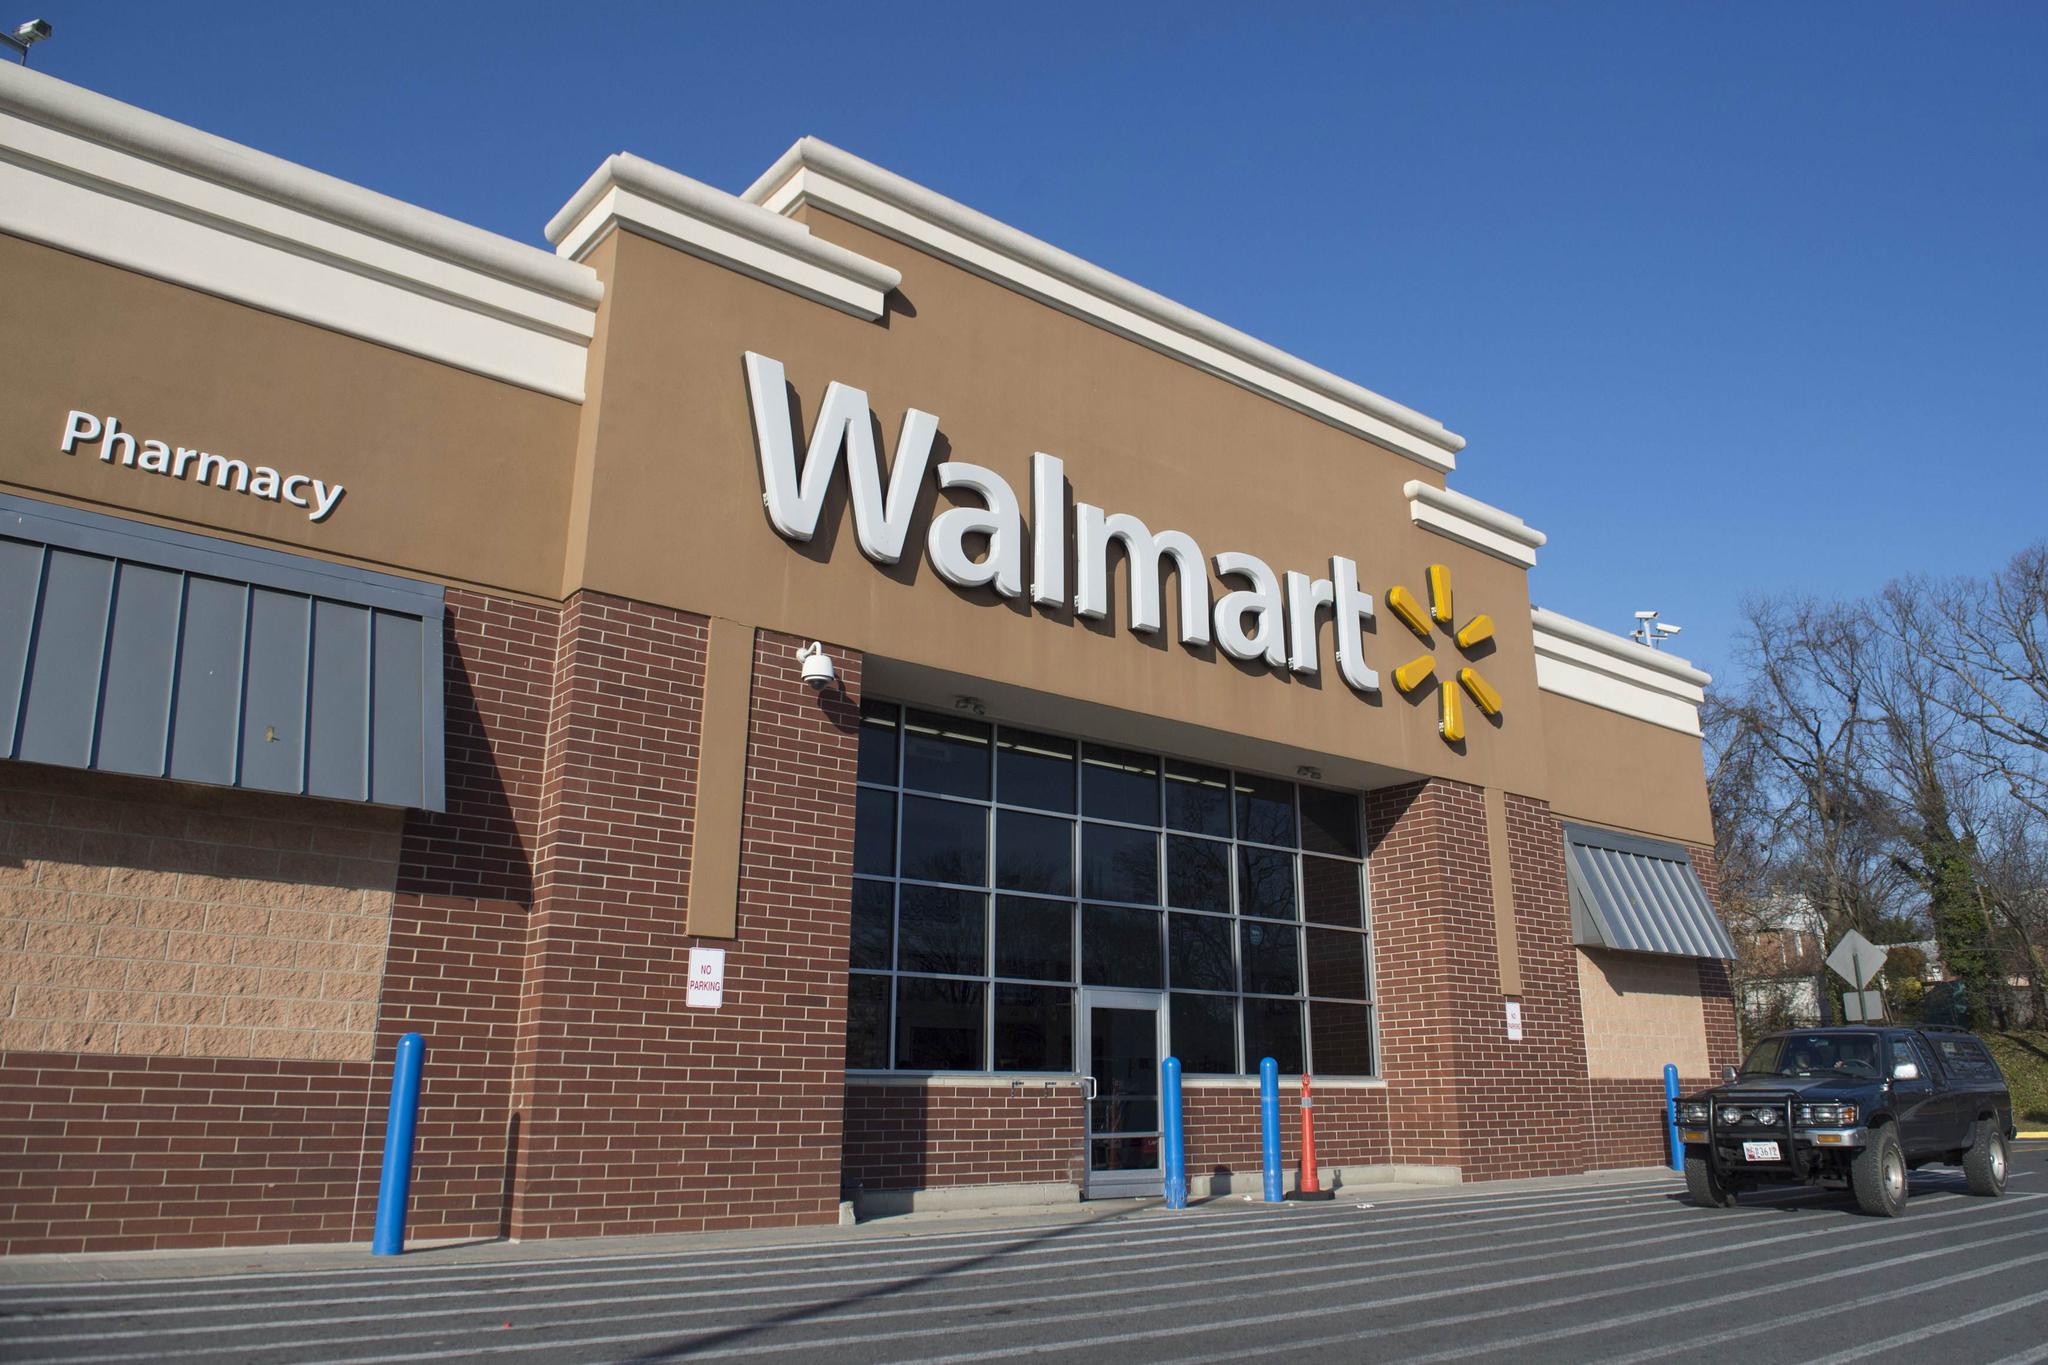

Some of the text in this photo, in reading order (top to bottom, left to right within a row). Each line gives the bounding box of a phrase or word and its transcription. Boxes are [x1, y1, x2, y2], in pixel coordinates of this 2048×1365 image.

[60, 409, 344, 522] Pharmacy
[744, 350, 1380, 692] Walmart
[689, 980, 721, 992] PARKING
[700, 964, 712, 975] NO
